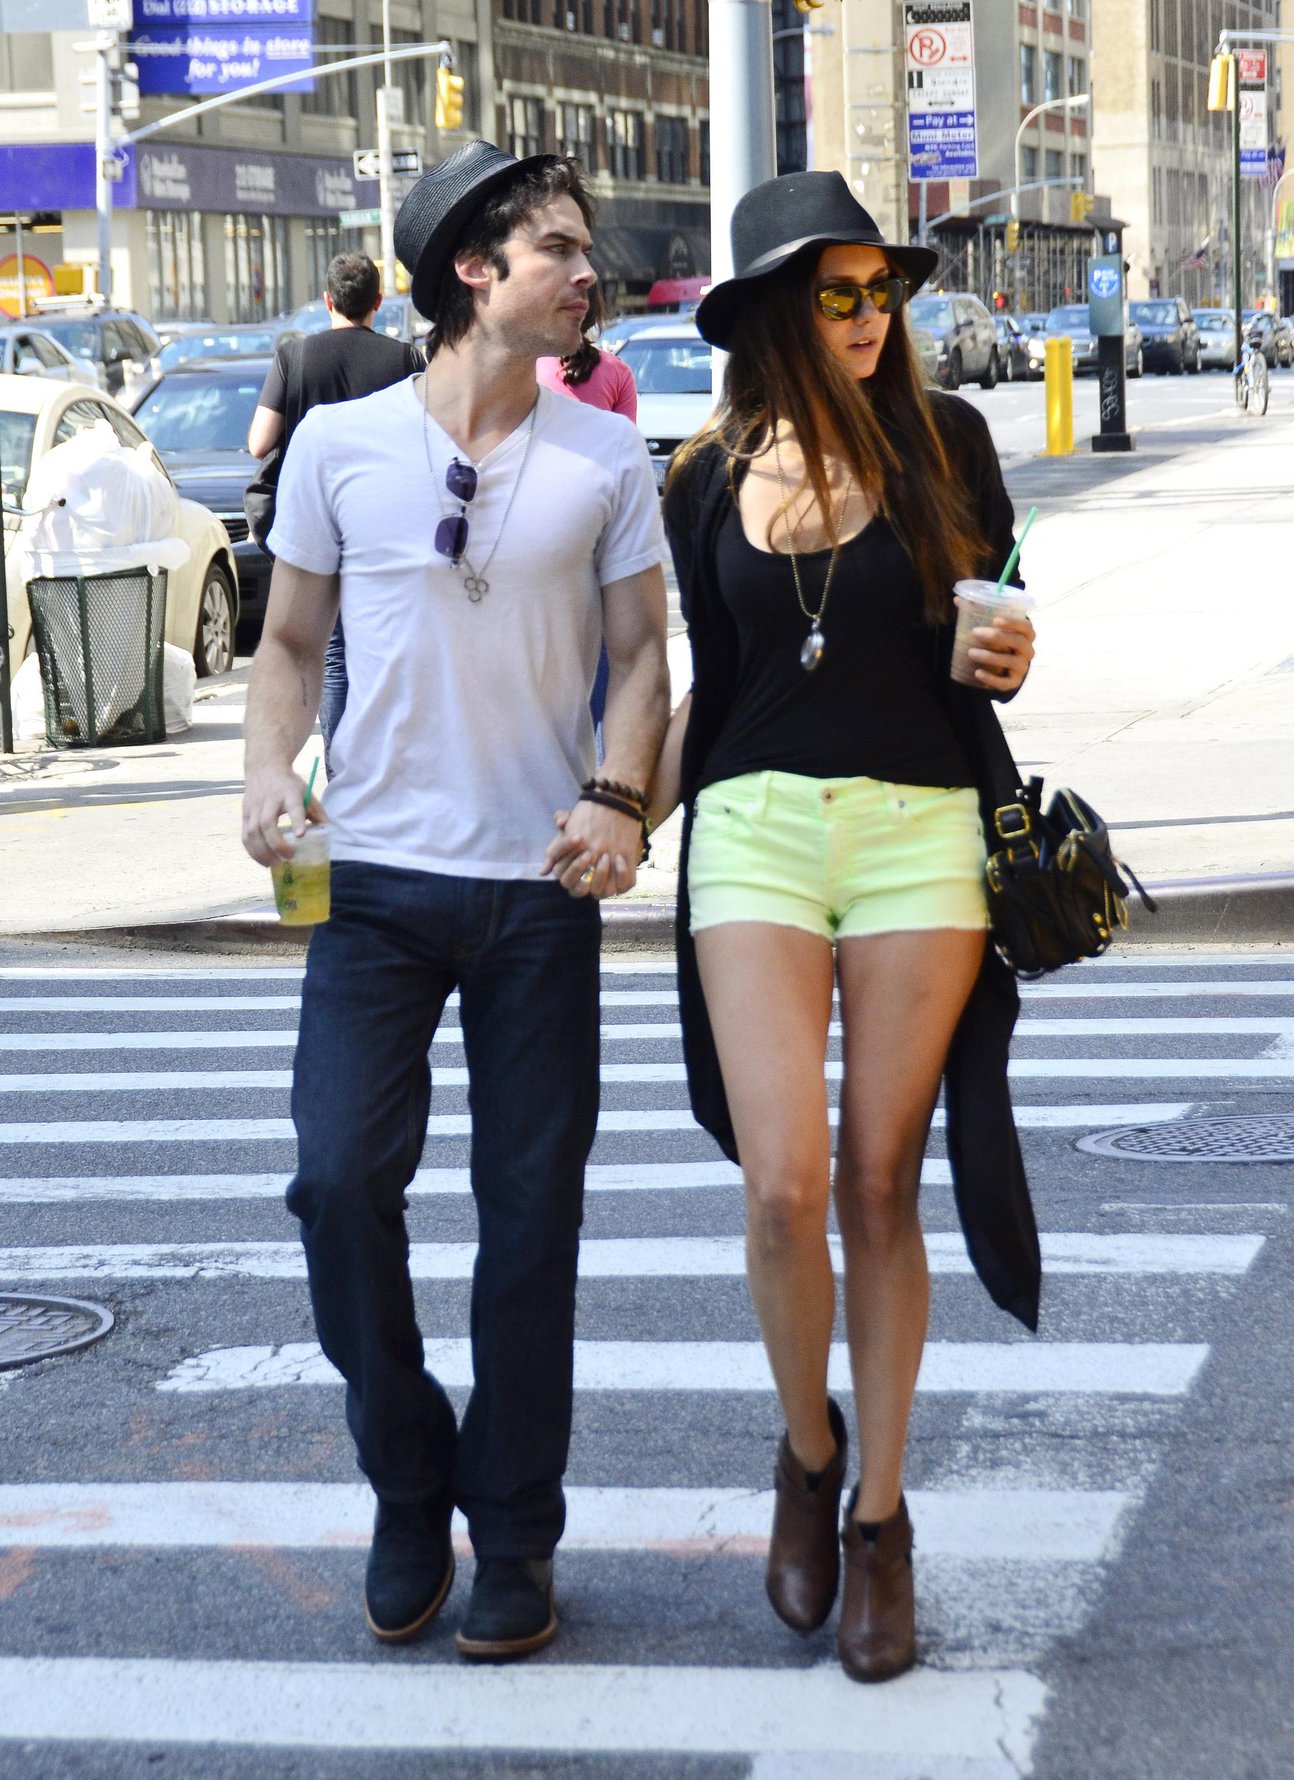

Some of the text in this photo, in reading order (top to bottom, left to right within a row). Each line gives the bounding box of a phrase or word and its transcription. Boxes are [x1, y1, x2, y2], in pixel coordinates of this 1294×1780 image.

[209, 0, 299, 15] STORAGE
[187, 36, 239, 61] things
[243, 35, 261, 56] in
[265, 36, 311, 55] store
[185, 57, 260, 83] for you!
[925, 114, 958, 128] Pay at
[1108, 232, 1118, 253] P
